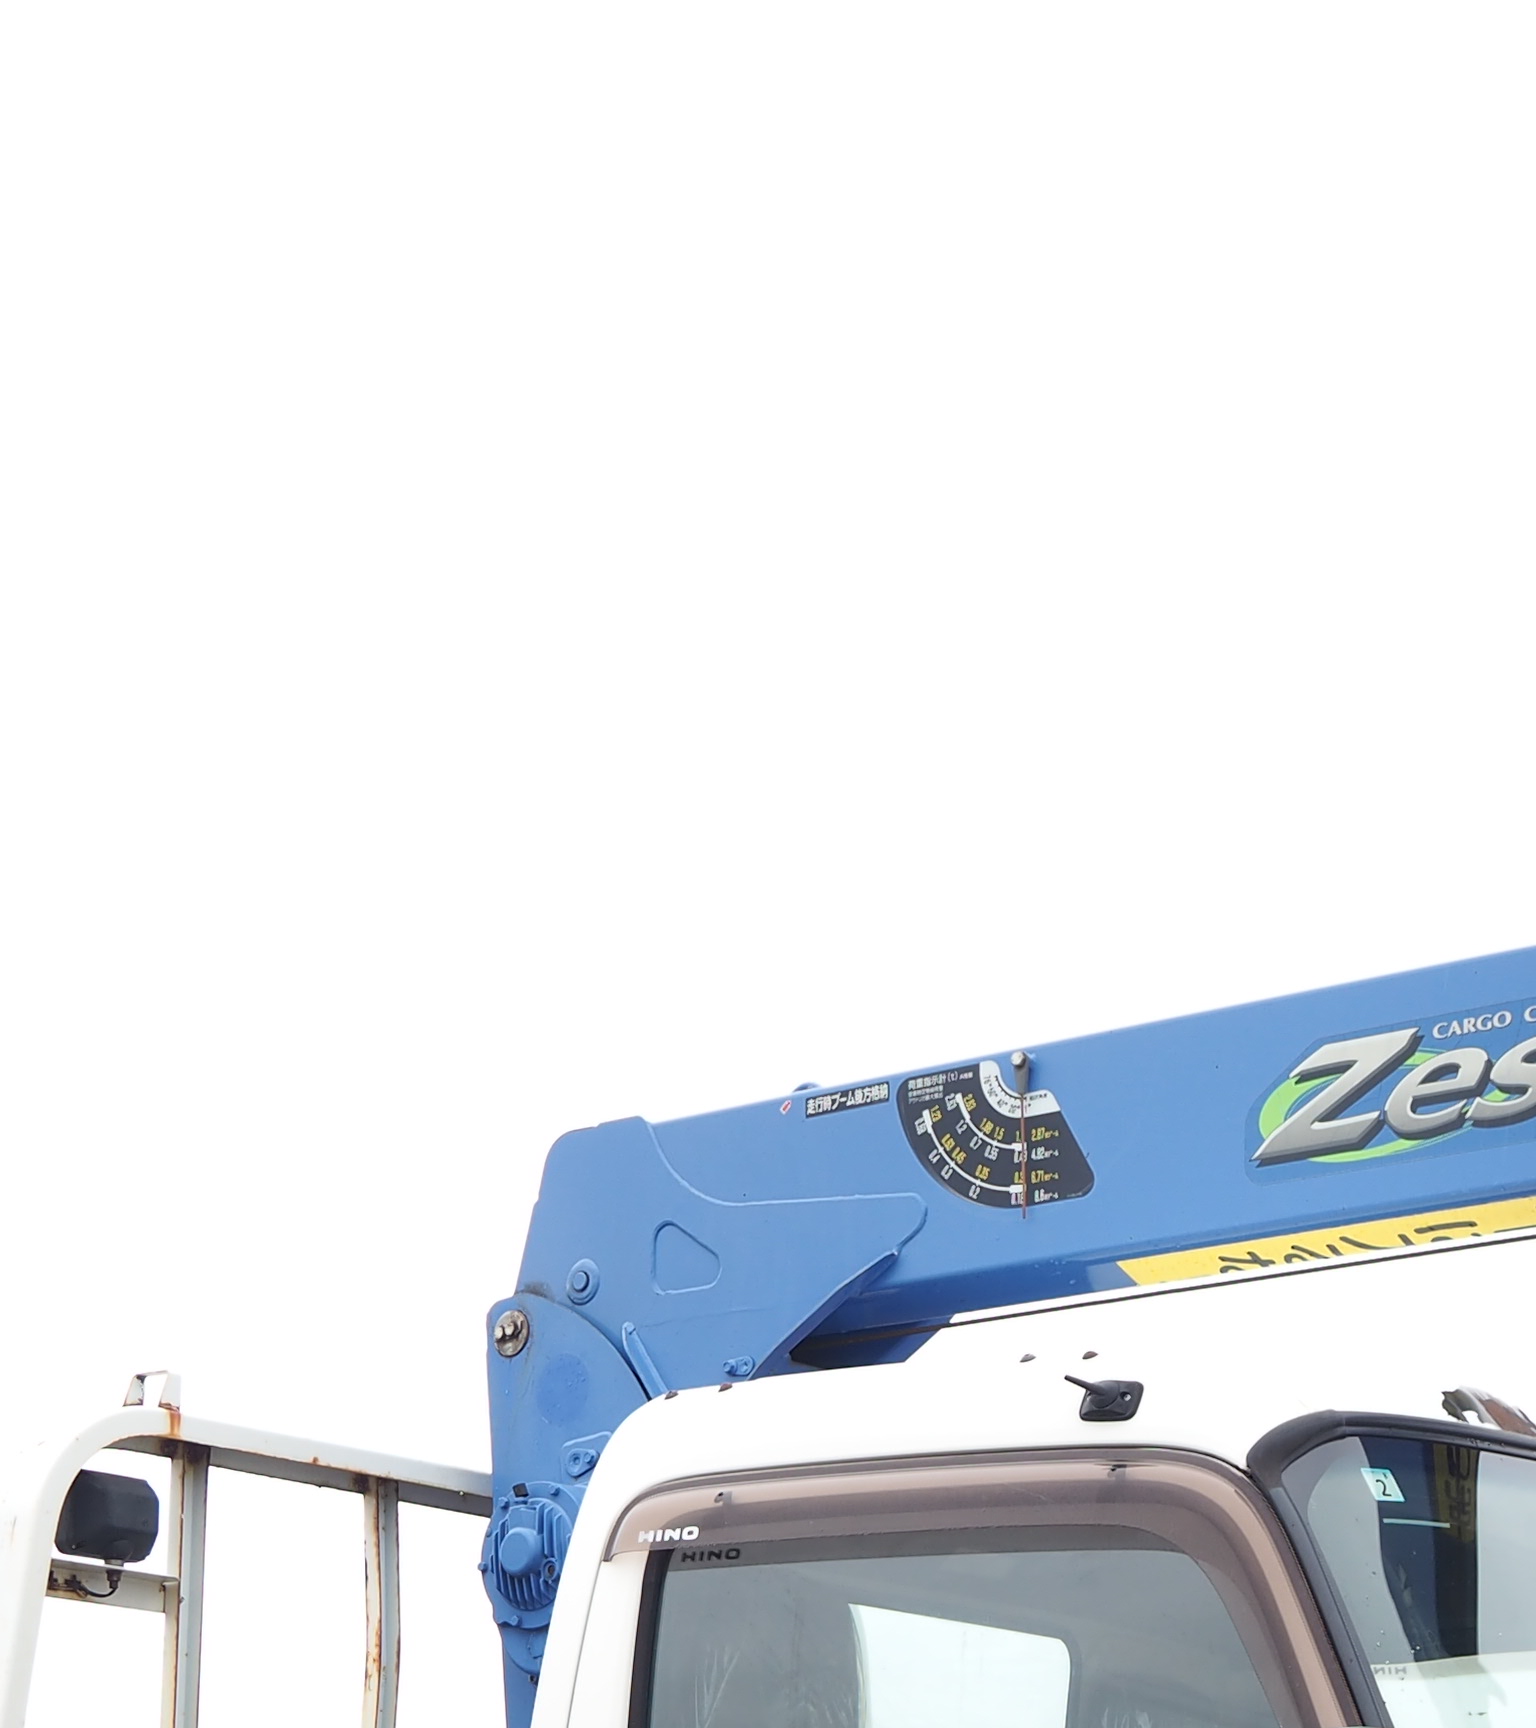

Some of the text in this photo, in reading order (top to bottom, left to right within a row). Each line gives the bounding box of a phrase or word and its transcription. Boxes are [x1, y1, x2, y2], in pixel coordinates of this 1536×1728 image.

[1431, 1010, 1512, 1040] CARGO
[1375, 1479, 1393, 1497] 2
[637, 1525, 700, 1543] HINO
[680, 1548, 741, 1563] HINO
